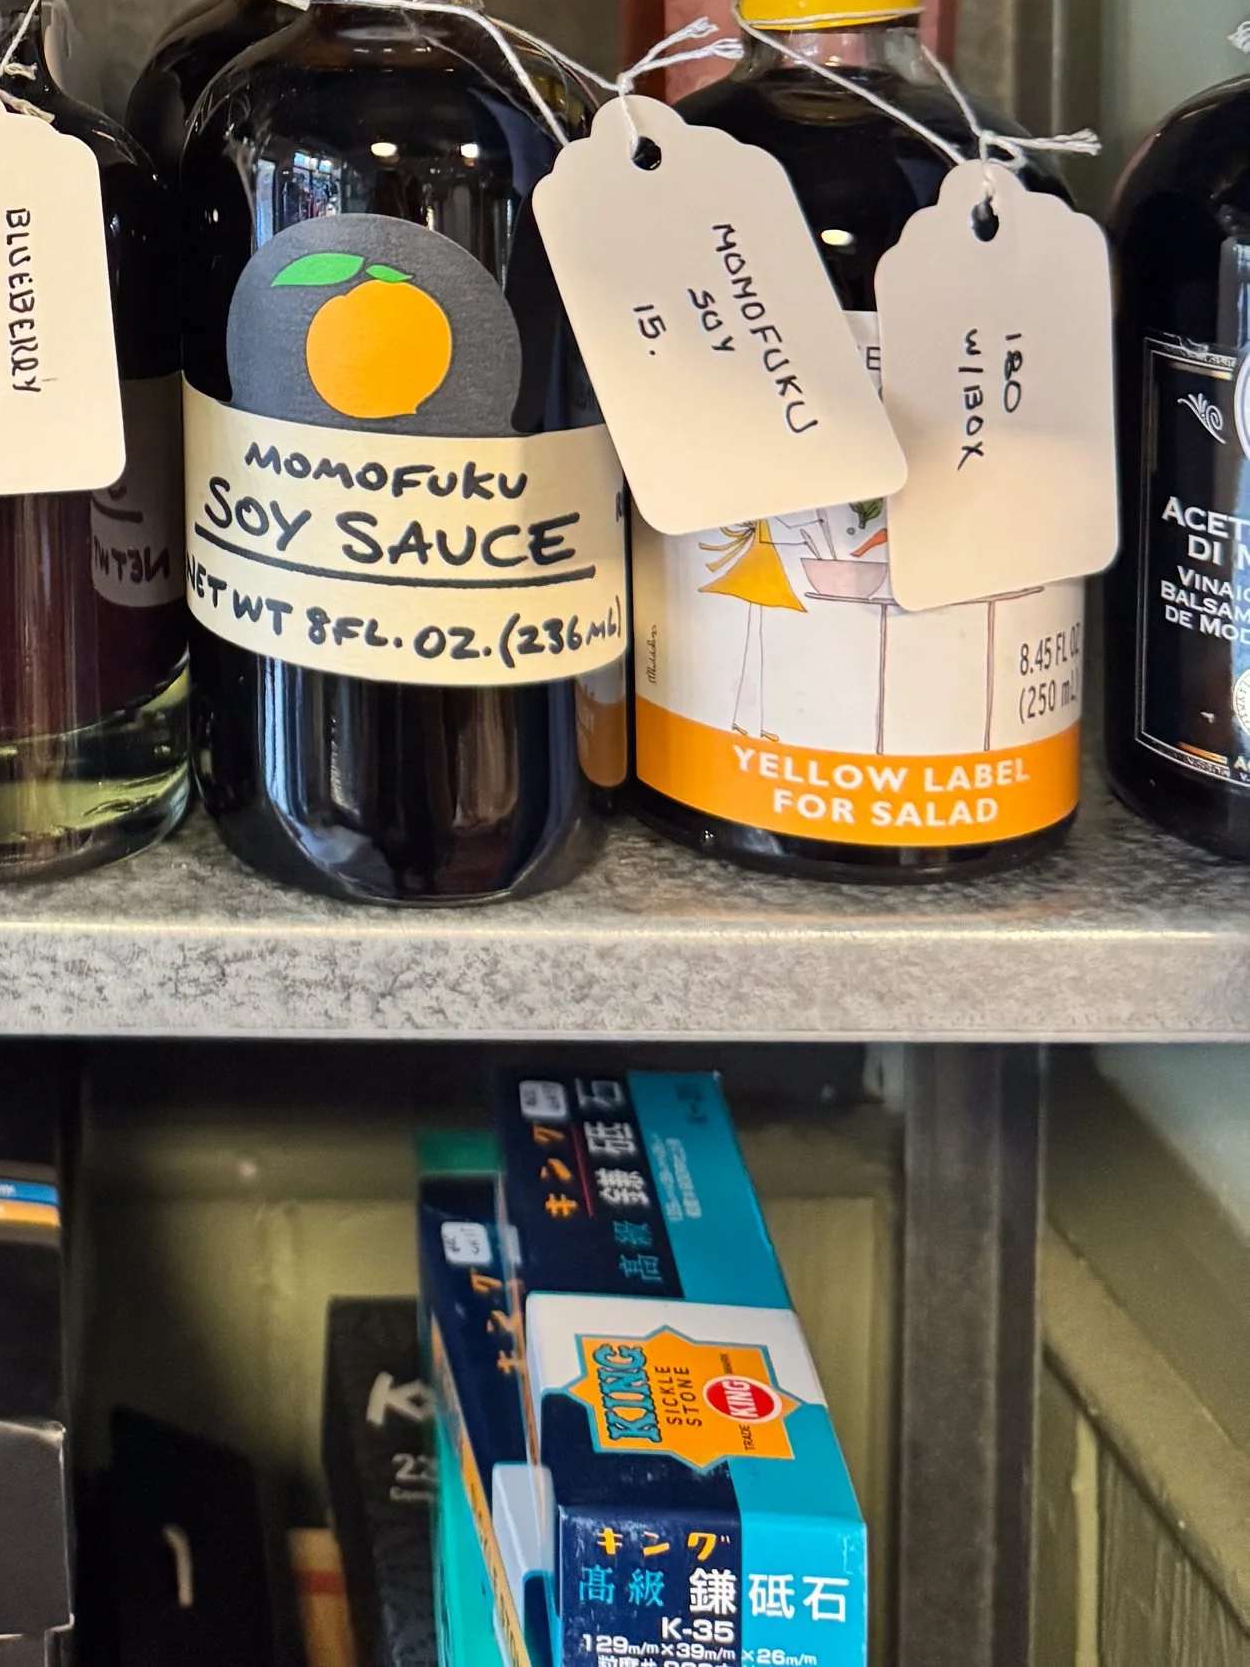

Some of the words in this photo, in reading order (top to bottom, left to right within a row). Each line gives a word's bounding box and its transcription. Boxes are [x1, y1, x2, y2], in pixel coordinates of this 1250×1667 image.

[5, 208, 42, 393] BLUEBERRY
[687, 287, 736, 353] SOY
[633, 303, 667, 356] 15.
[711, 223, 818, 433] MOMOFUKU
[1002, 332, 1022, 413] 180
[245, 441, 528, 501] MOMOFUKU
[204, 476, 312, 551] SOY
[336, 512, 581, 568] SAUCE
[1188, 534, 1222, 566] DI
[186, 553, 227, 608] NET
[233, 589, 293, 636] WT
[1165, 604, 1194, 631] DE
[1020, 636, 1052, 675] 8.45
[1055, 632, 1068, 665] FL
[1019, 679, 1055, 724] (250
[733, 745, 909, 795] YELLOW
[925, 758, 1031, 793] LABEL
[773, 788, 854, 825] FOR
[871, 797, 999, 829] SALAD
[593, 1343, 662, 1443] KING
[655, 1365, 683, 1426] SICKLE
[673, 1367, 703, 1427] STONE
[722, 1379, 758, 1418] KING
[739, 1424, 756, 1452] TRADE
[597, 1527, 730, 1561] キング
[661, 1616, 735, 1643] K-35
